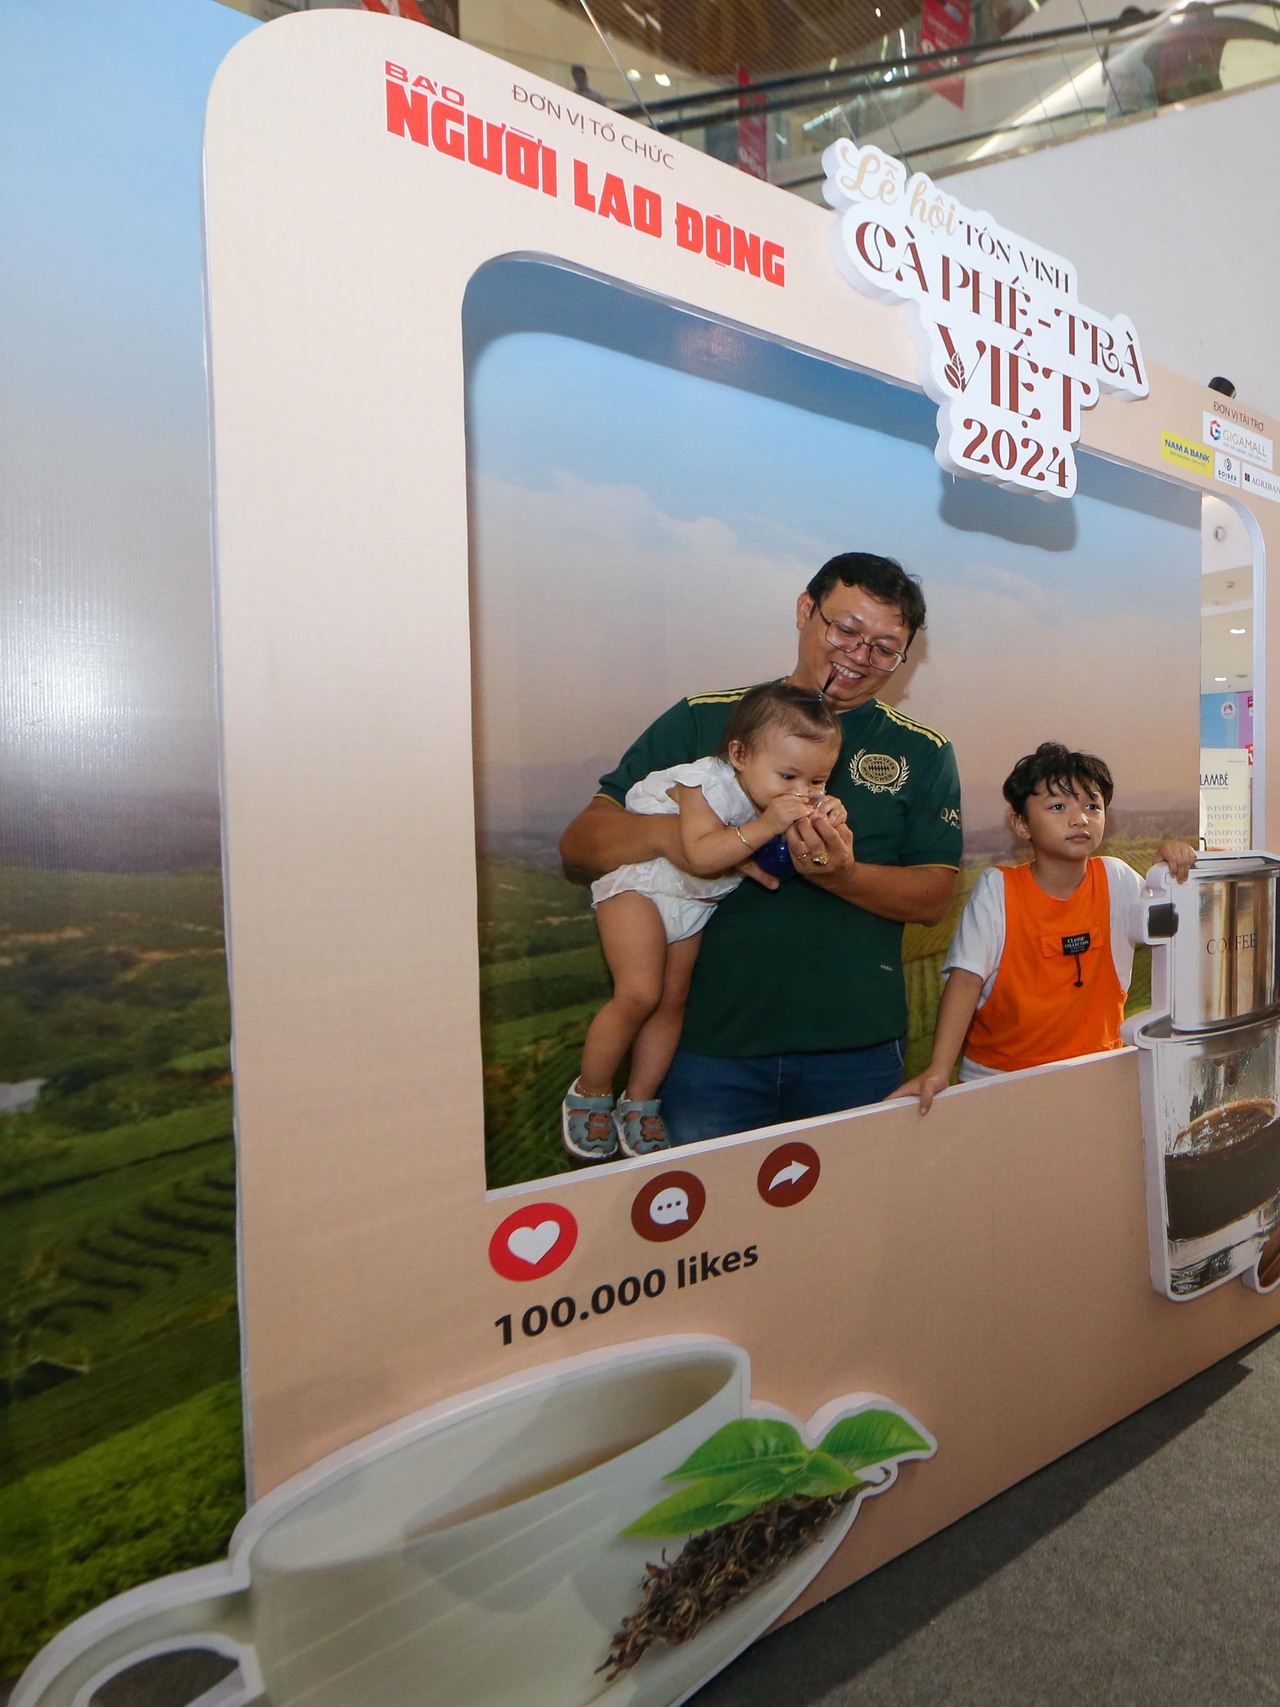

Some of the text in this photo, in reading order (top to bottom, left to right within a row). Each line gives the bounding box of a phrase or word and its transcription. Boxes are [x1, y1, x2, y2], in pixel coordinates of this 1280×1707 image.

[385, 60, 465, 107] BÁO
[511, 84, 675, 170] ĐƠN VỊ TỔ CHỨC
[385, 79, 557, 198] NGƯỜI
[573, 157, 663, 239] LAO
[674, 201, 786, 288] ĐỘNG
[840, 145, 1070, 293] Lễ hội TÔN VINH
[855, 221, 929, 293] CÀ
[933, 320, 1091, 433] VIỆT
[962, 417, 1069, 489] 2024
[1164, 438, 1183, 453] NAM
[1183, 446, 1189, 455] A
[1189, 448, 1210, 463] BANK
[1222, 429, 1267, 457] GIGAMALL
[940, 807, 960, 823] QA
[1206, 933, 1256, 955] COFEE
[494, 1245, 759, 1346] 100.000 likes
